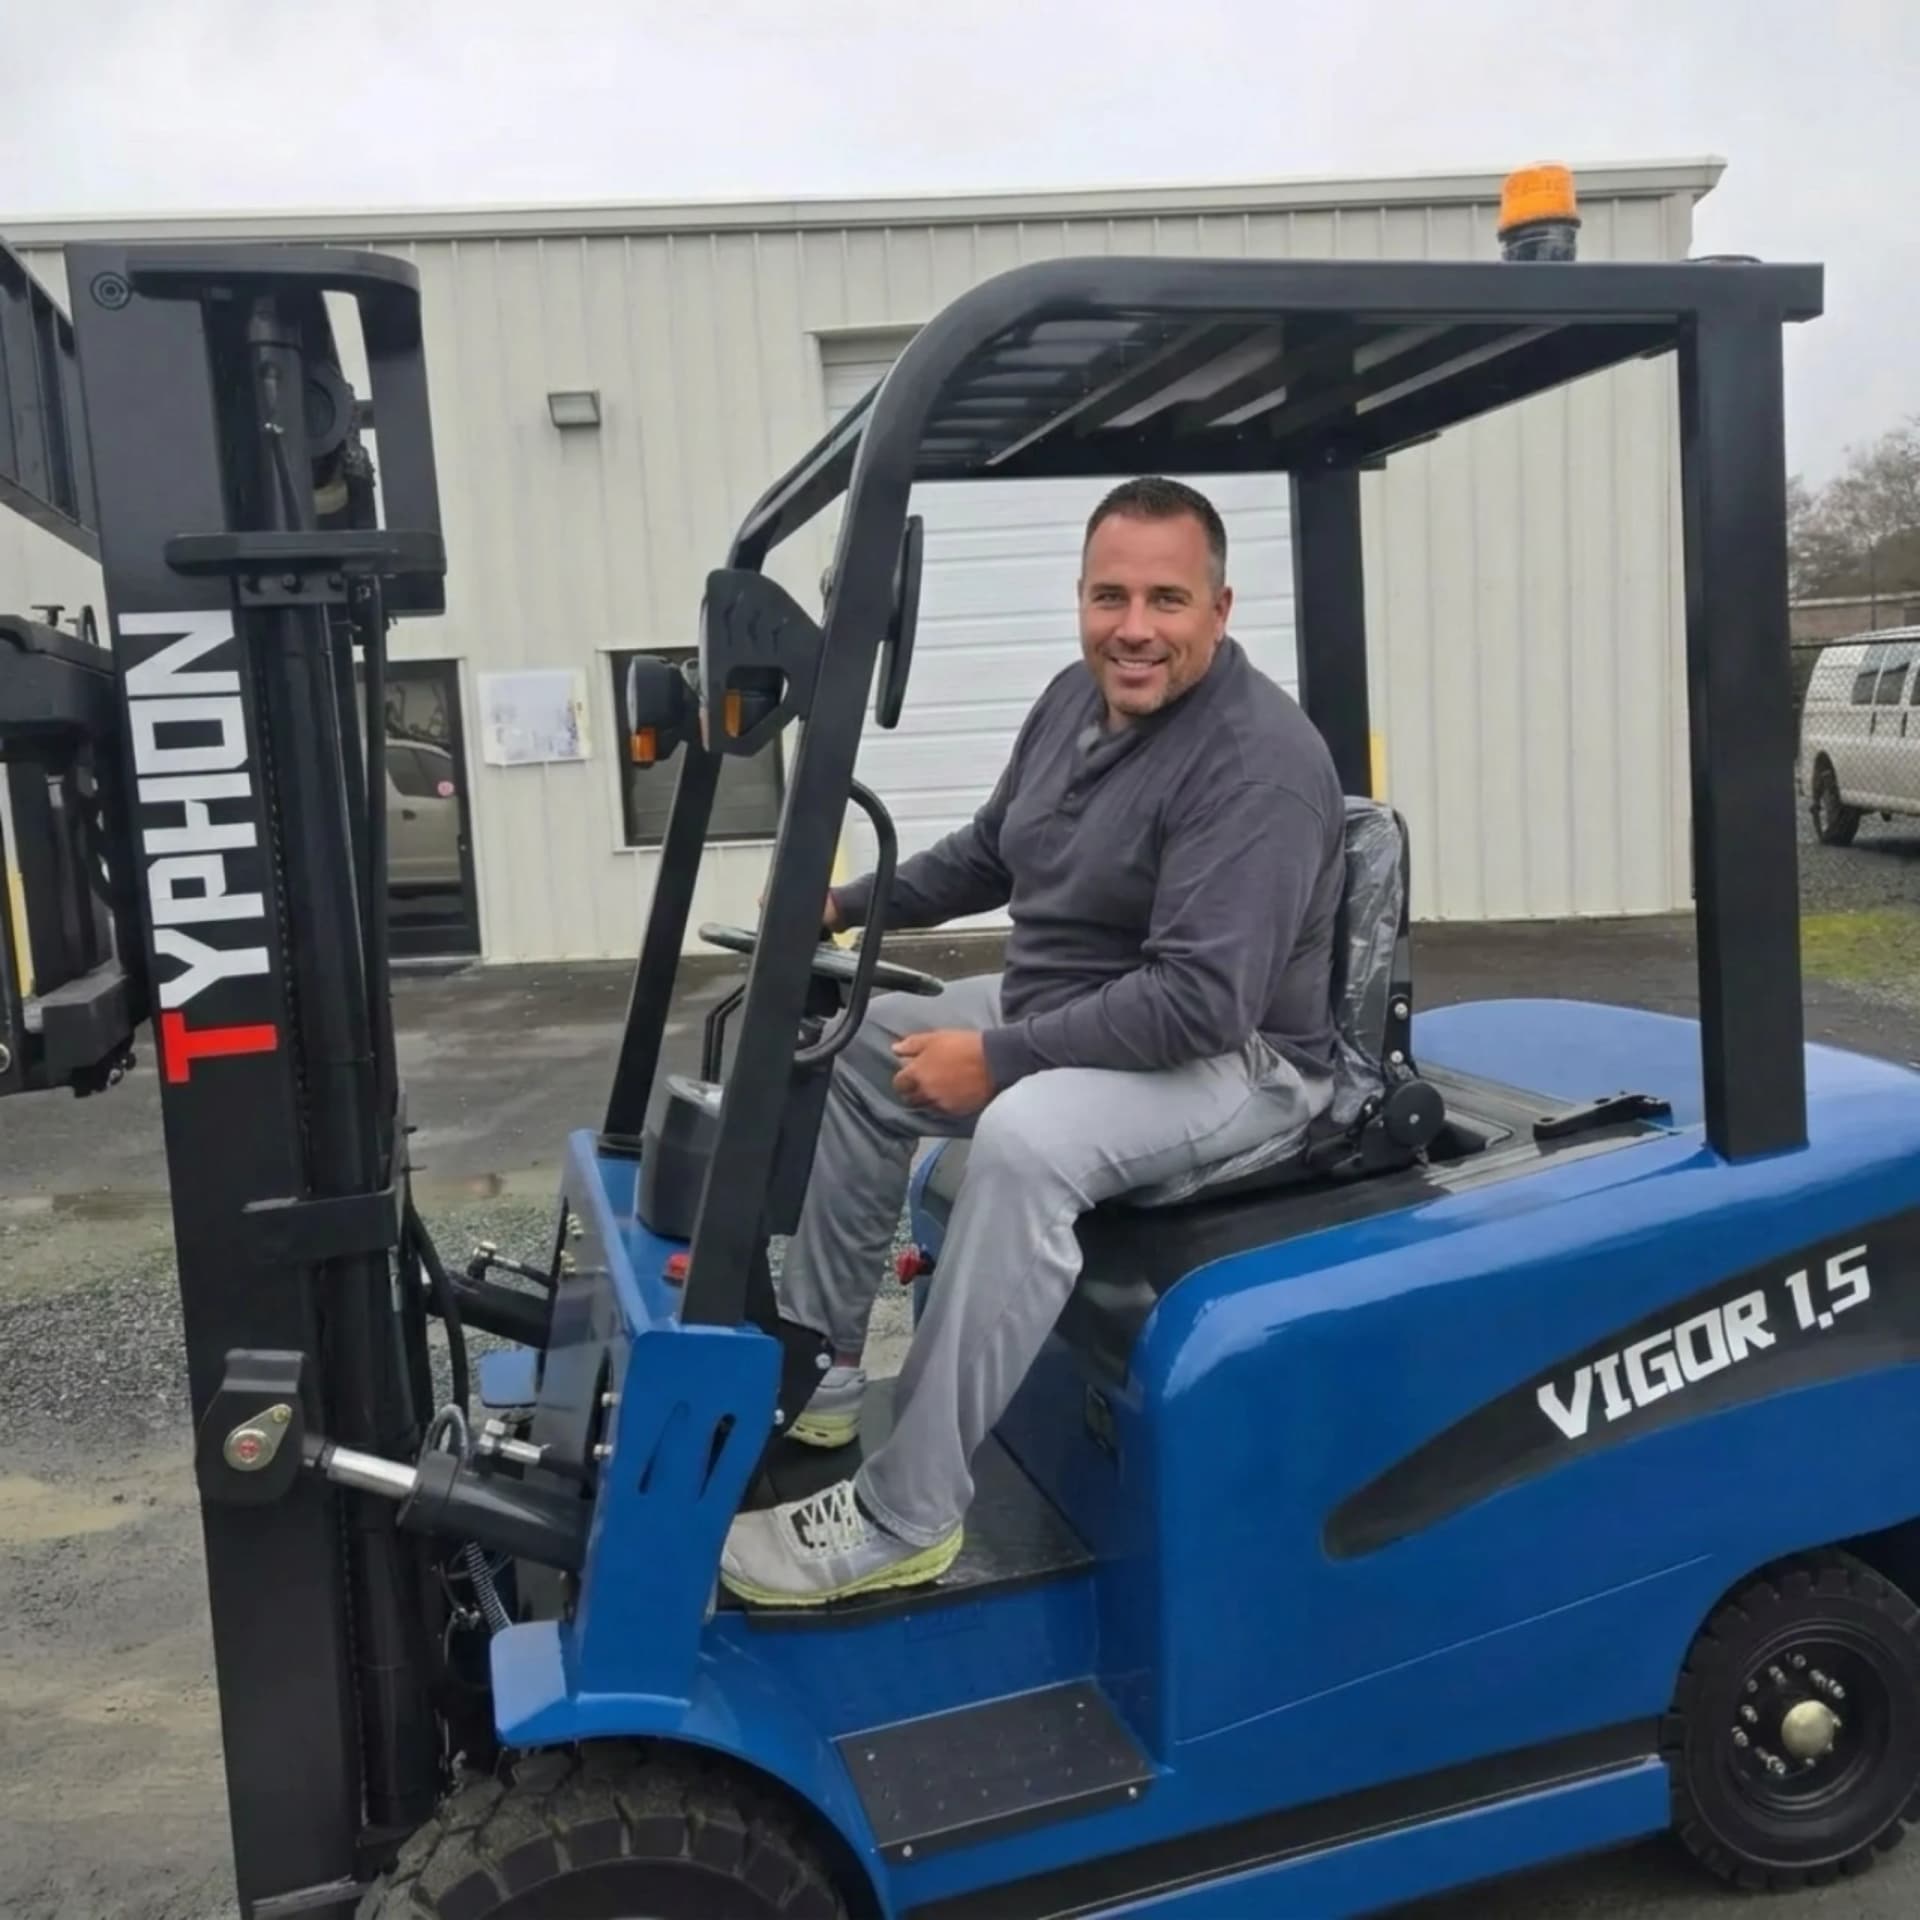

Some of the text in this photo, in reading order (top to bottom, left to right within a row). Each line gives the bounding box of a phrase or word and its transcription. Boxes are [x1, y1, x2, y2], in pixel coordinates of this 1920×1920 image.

[118, 610, 278, 1083] TYPHON
[1537, 1245, 1870, 1439] VIGOR 1.5
